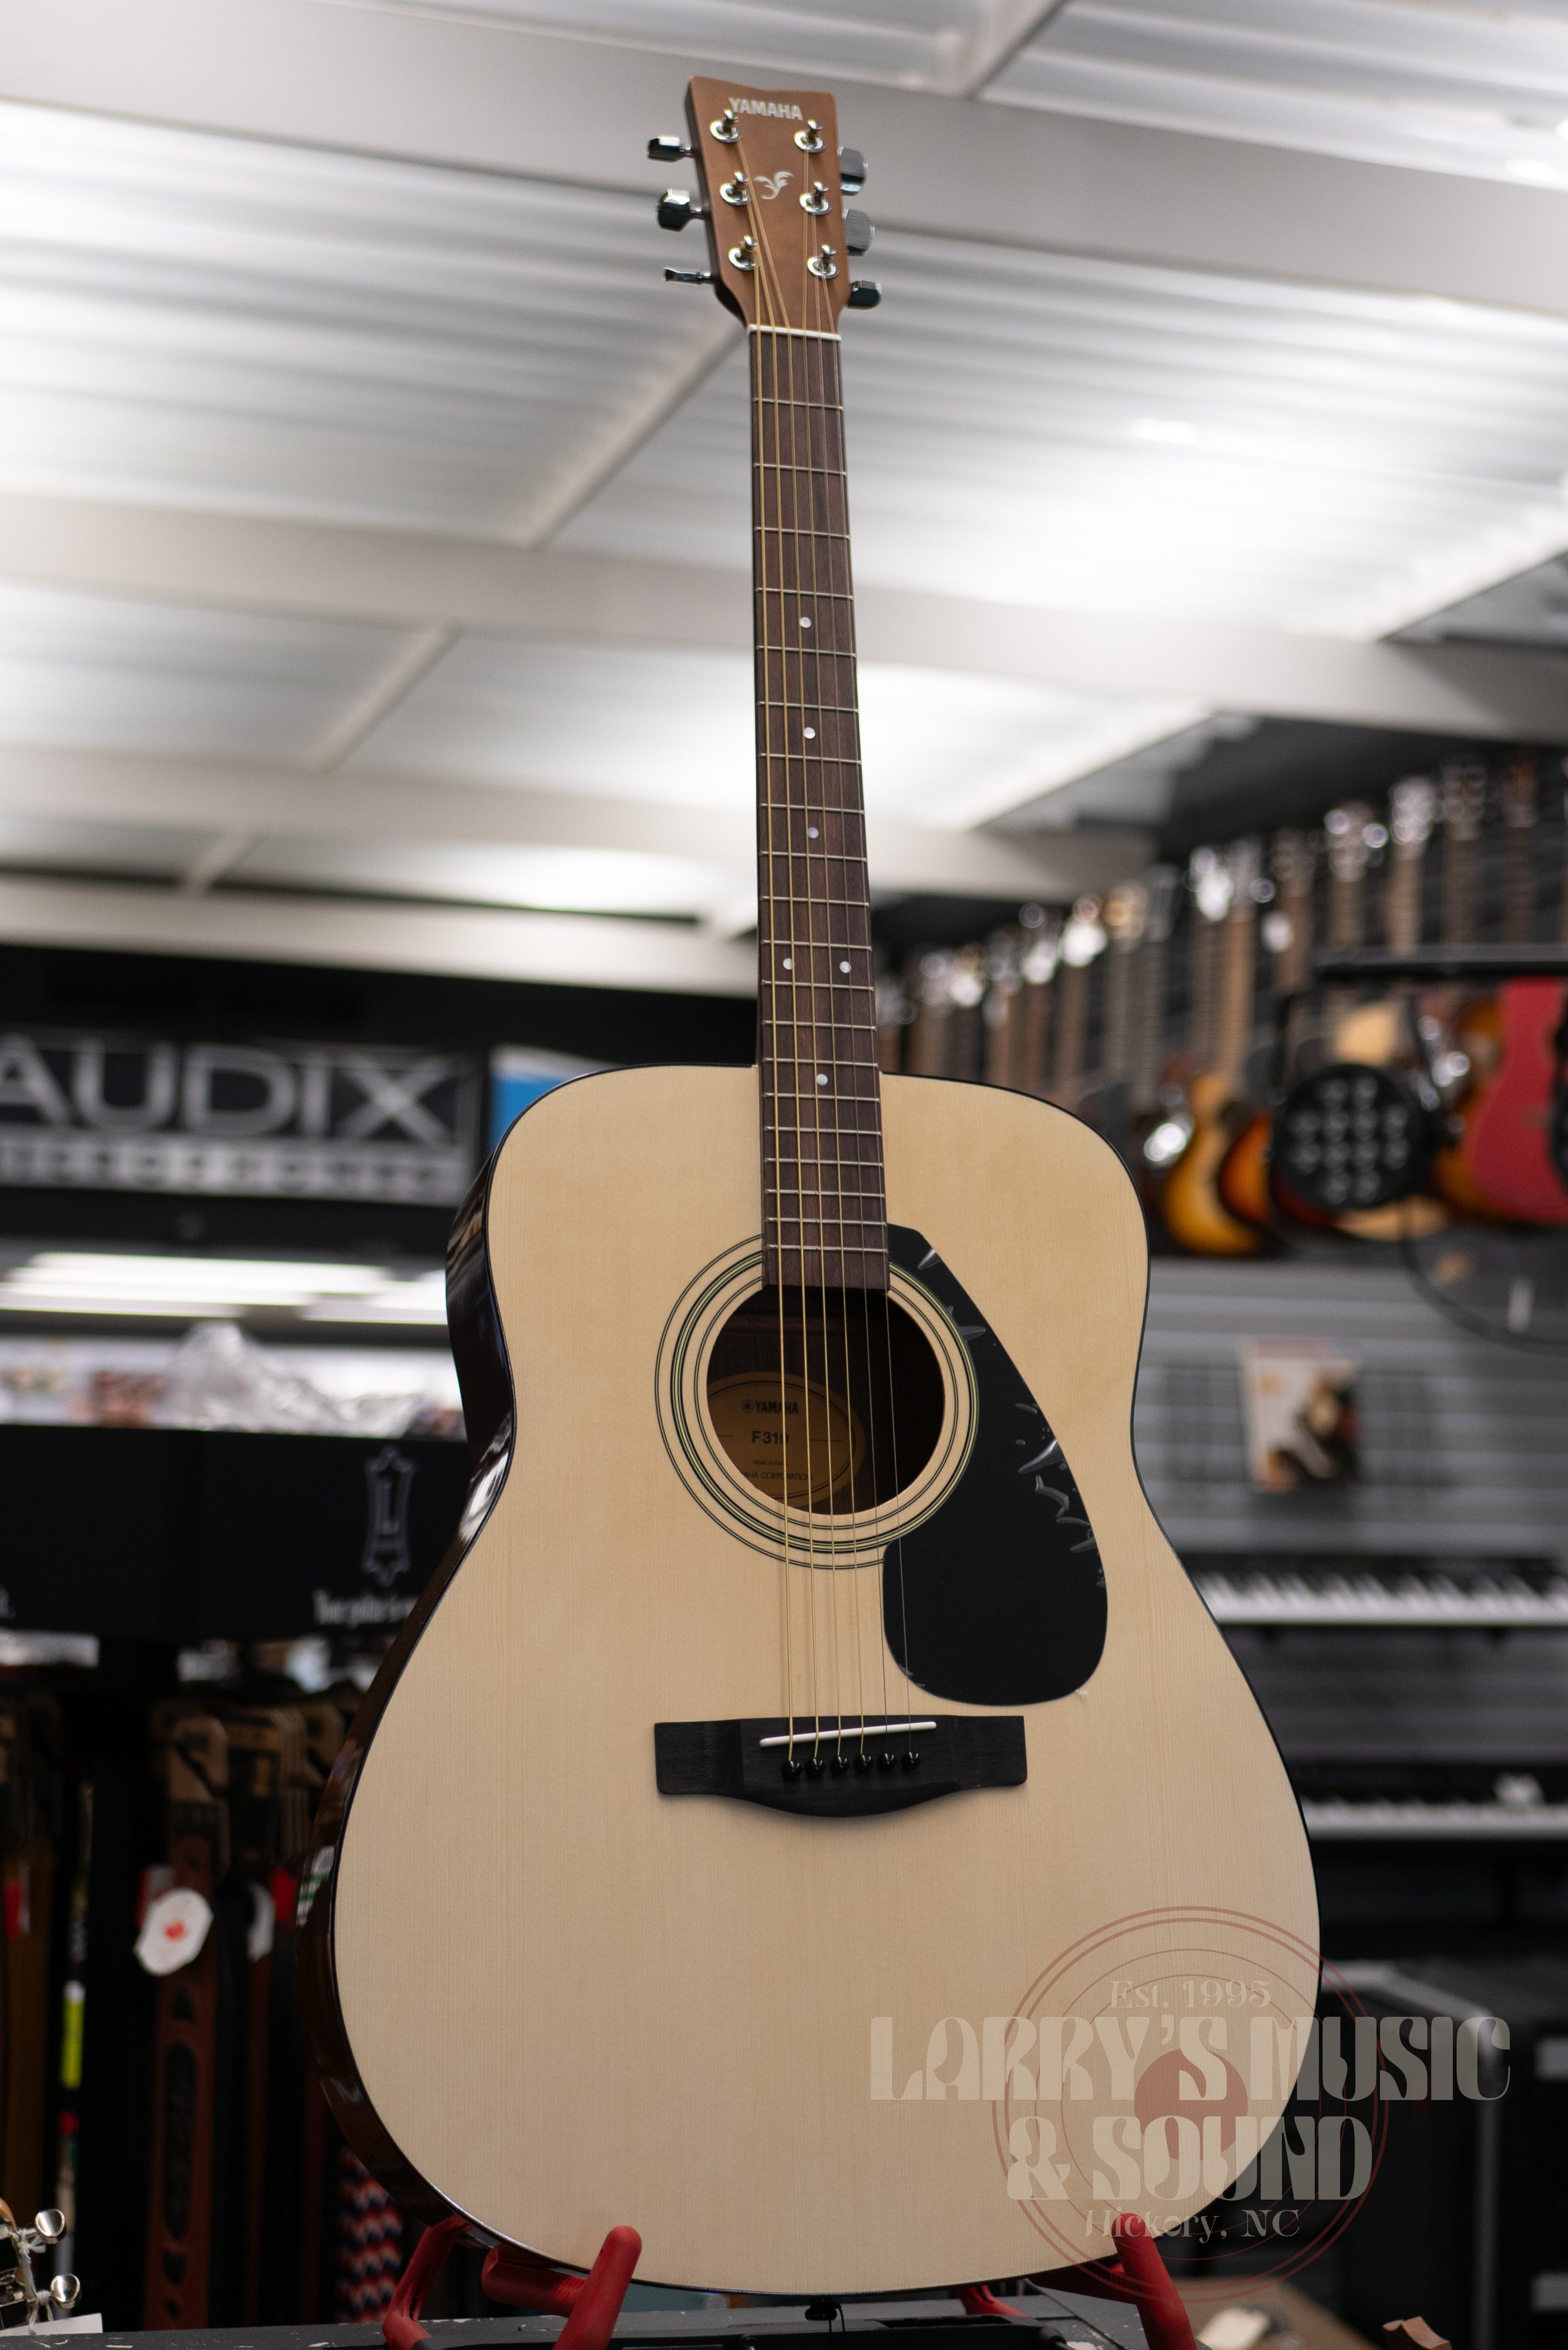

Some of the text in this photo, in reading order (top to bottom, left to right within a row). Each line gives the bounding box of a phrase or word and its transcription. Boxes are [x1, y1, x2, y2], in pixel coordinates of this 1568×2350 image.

[728, 98, 803, 120] YAMAHA
[0, 1032, 452, 1147] AUDIX
[755, 1401, 799, 1414] YAMAHA
[752, 1431, 789, 1444] F310
